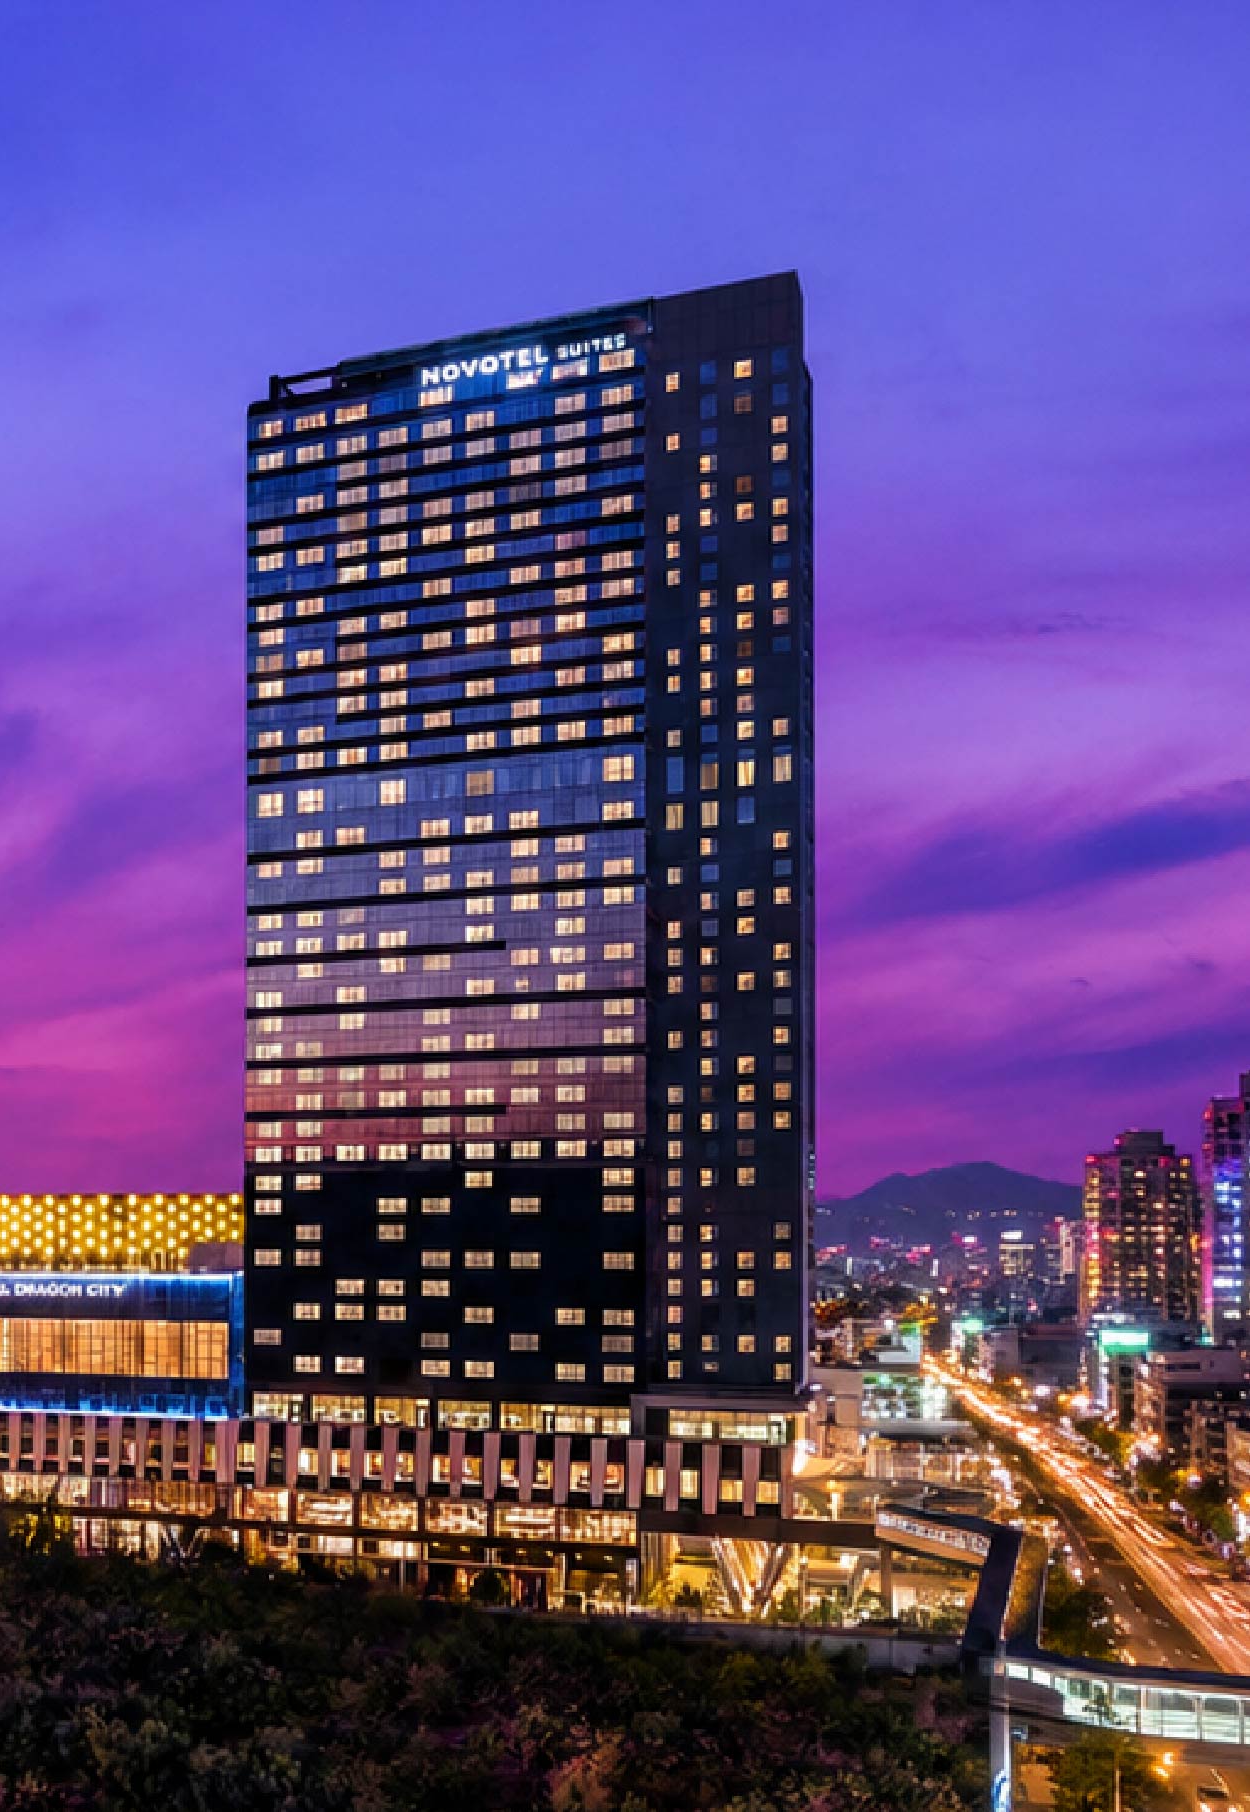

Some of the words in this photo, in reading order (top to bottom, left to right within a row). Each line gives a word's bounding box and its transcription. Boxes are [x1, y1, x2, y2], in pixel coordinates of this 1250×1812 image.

[421, 345, 549, 387] NOVOTEL
[557, 332, 626, 360] SUITES
[86, 1283, 126, 1297] CITY
